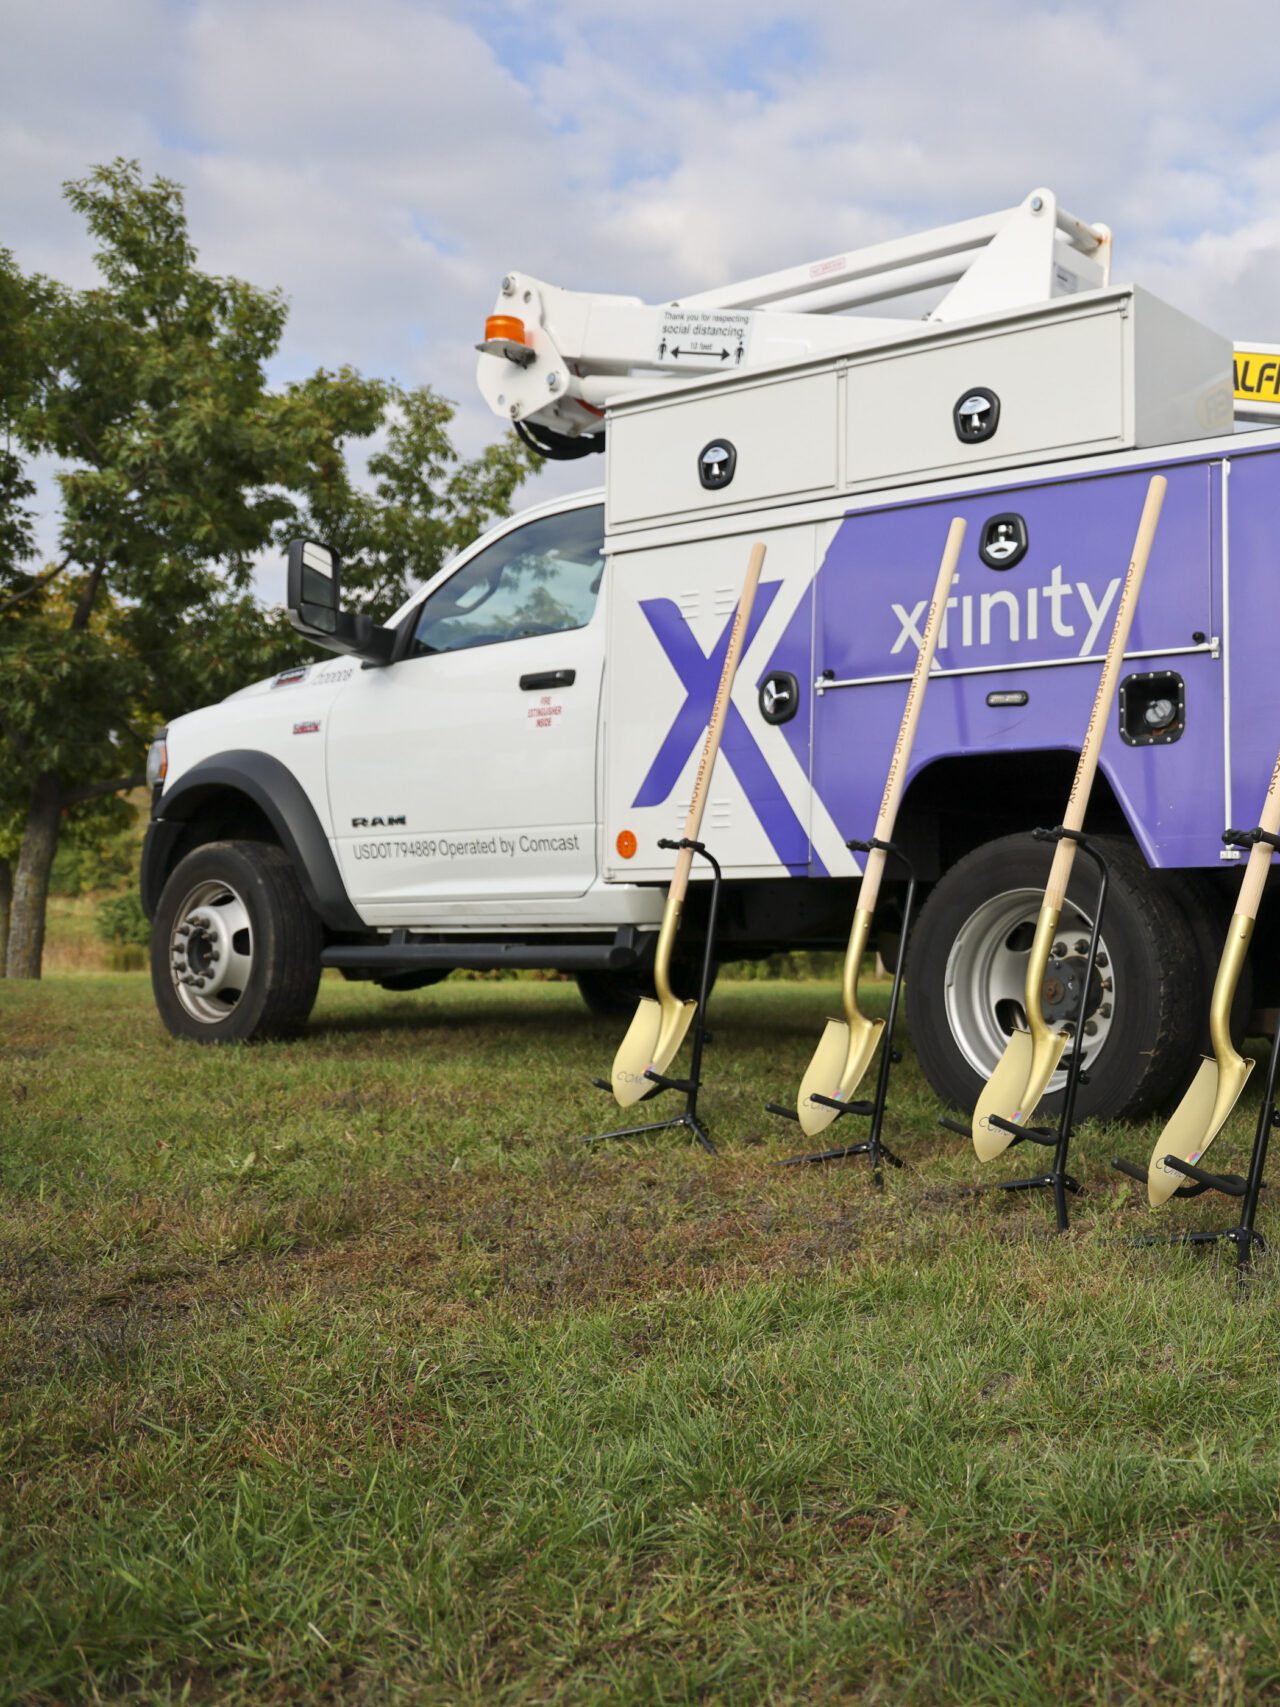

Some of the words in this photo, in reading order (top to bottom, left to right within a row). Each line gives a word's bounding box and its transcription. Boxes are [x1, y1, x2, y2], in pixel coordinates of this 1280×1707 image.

[664, 311, 685, 321] Thank
[686, 314, 699, 322] you
[712, 315, 749, 325] respecting
[662, 324, 690, 335] social
[351, 814, 407, 828] RAM
[438, 838, 496, 859] Operated
[499, 838, 515, 857] by
[518, 834, 580, 853] Comcast
